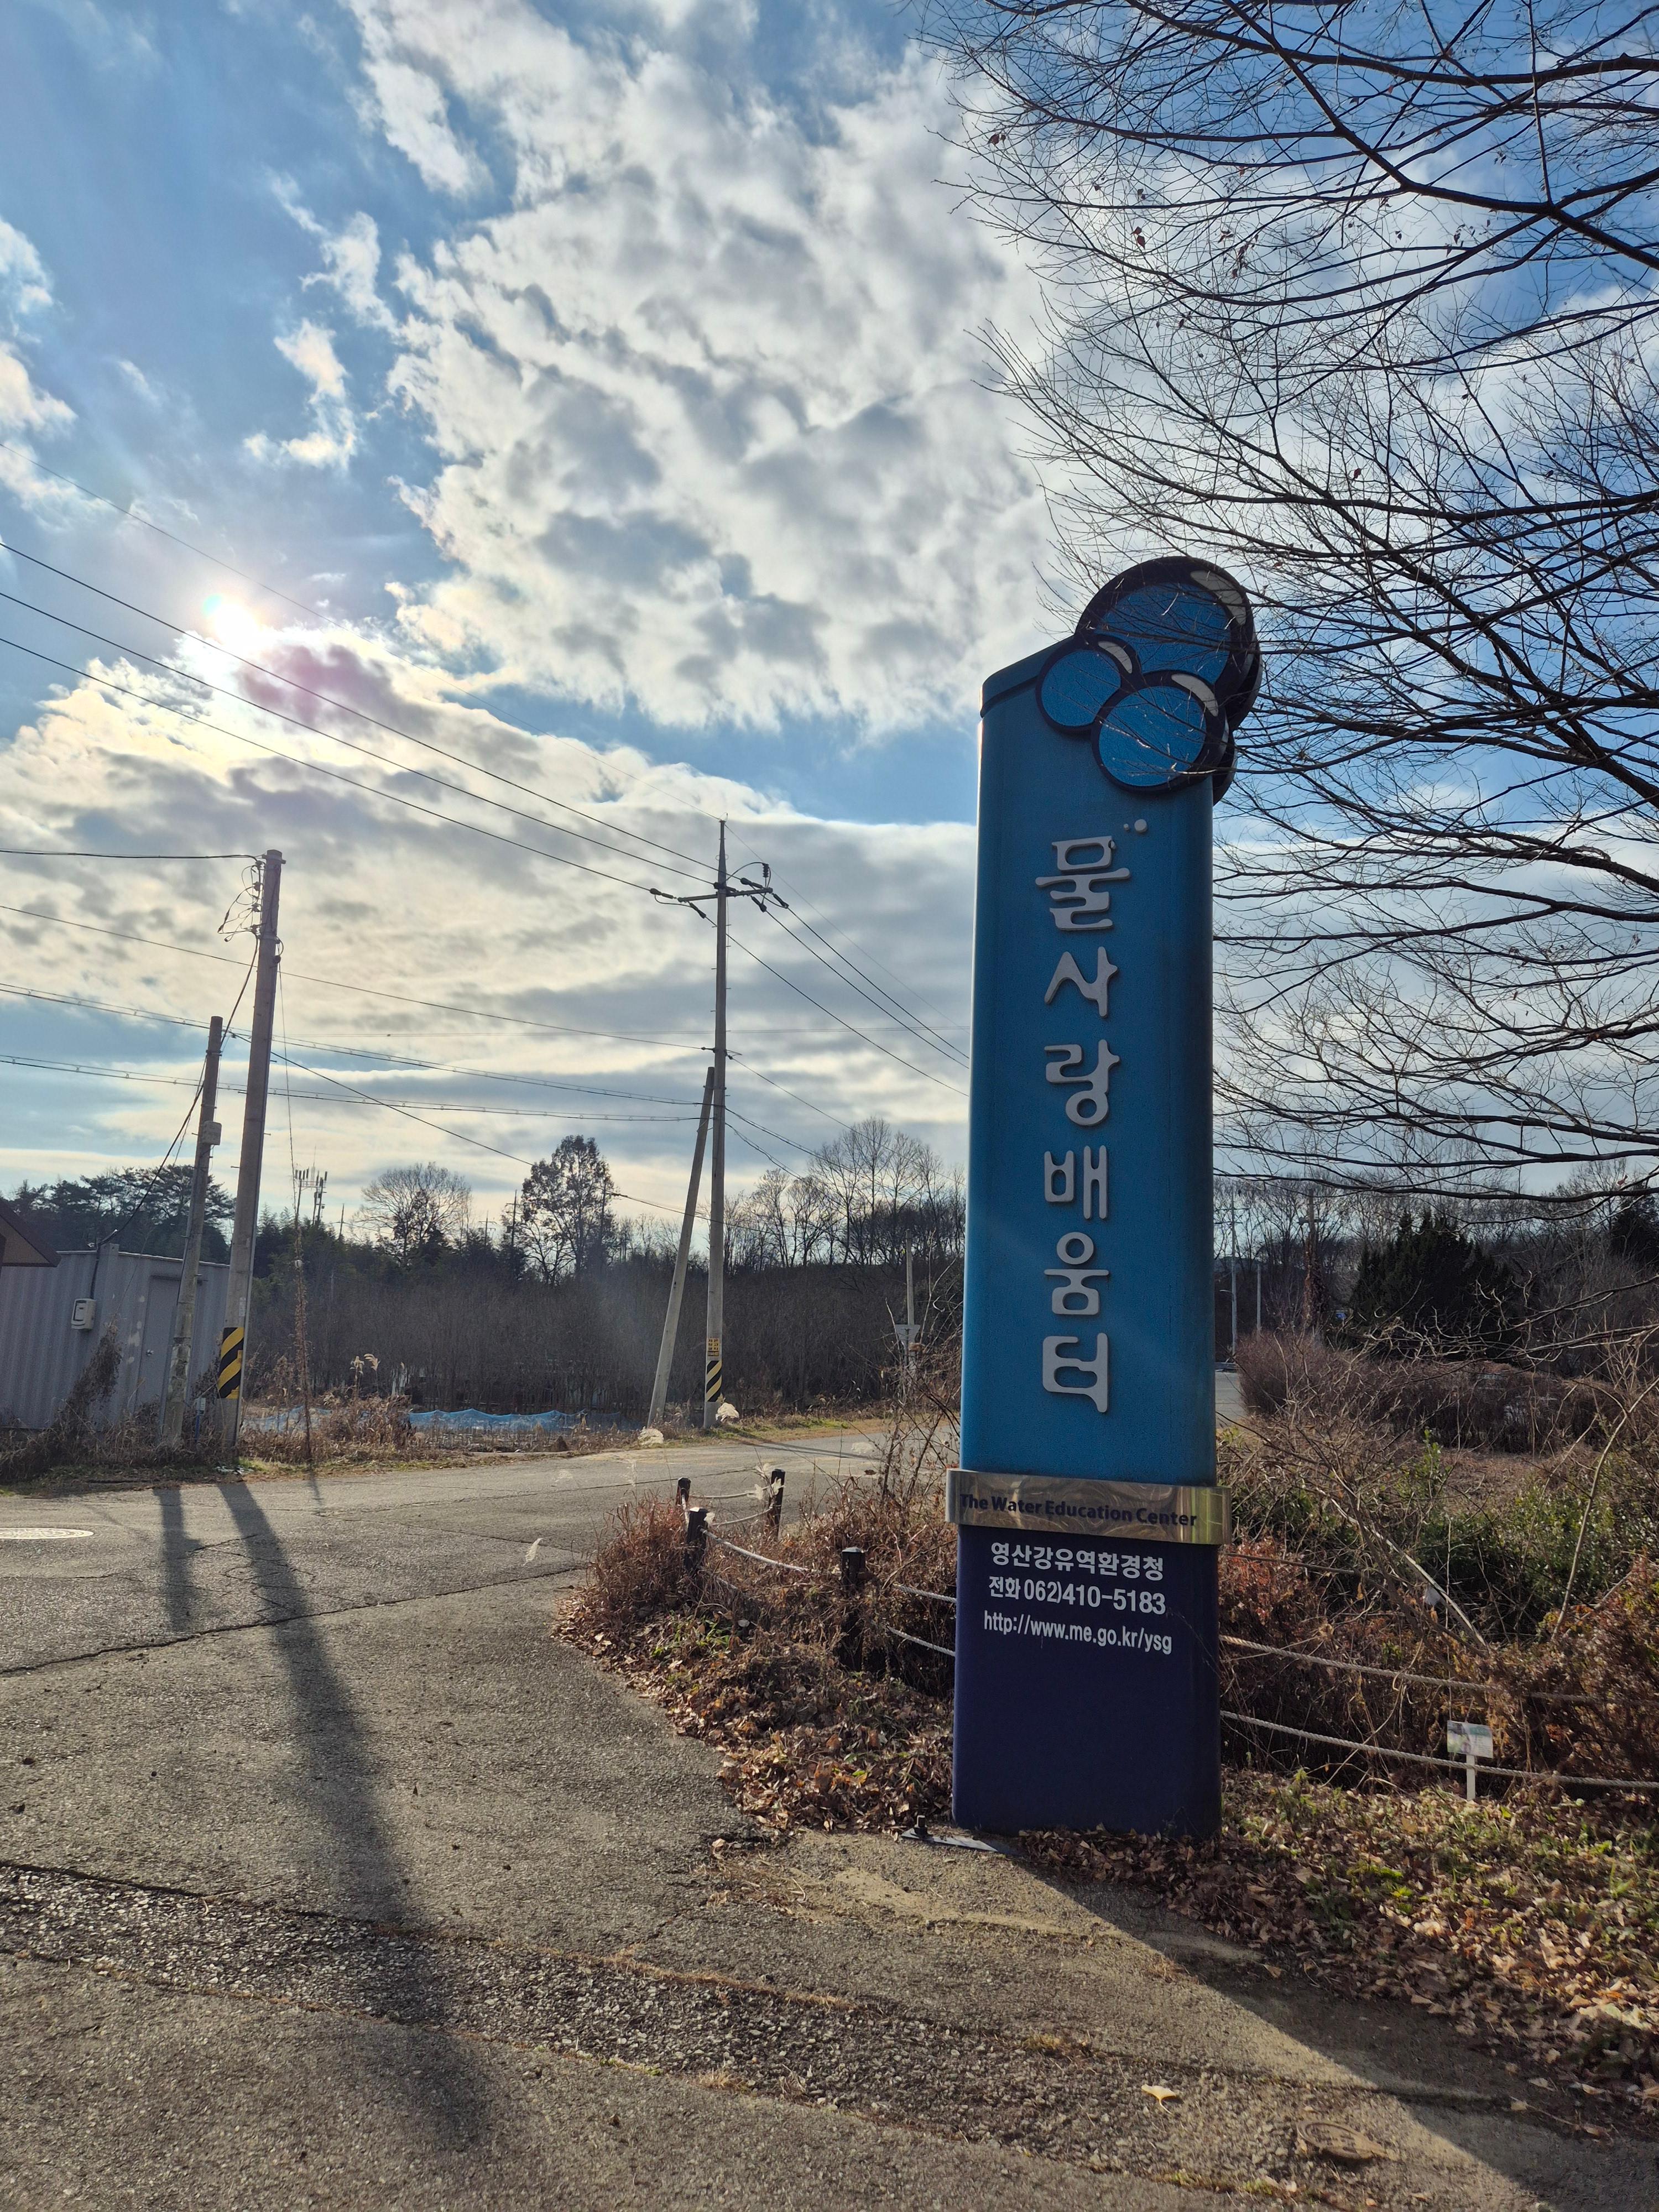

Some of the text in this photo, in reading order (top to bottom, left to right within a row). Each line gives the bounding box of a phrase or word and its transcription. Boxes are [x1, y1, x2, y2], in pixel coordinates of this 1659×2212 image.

[1035, 836, 1130, 1413] 물사랑배움터
[960, 1494, 1197, 1526] The Water Education Center
[991, 1542, 1164, 1581] 영산강유역환경청
[989, 1576, 1166, 1615] 전화 062)410-5183
[984, 1610, 1172, 1655] http://www.me.go.kr/ysg
